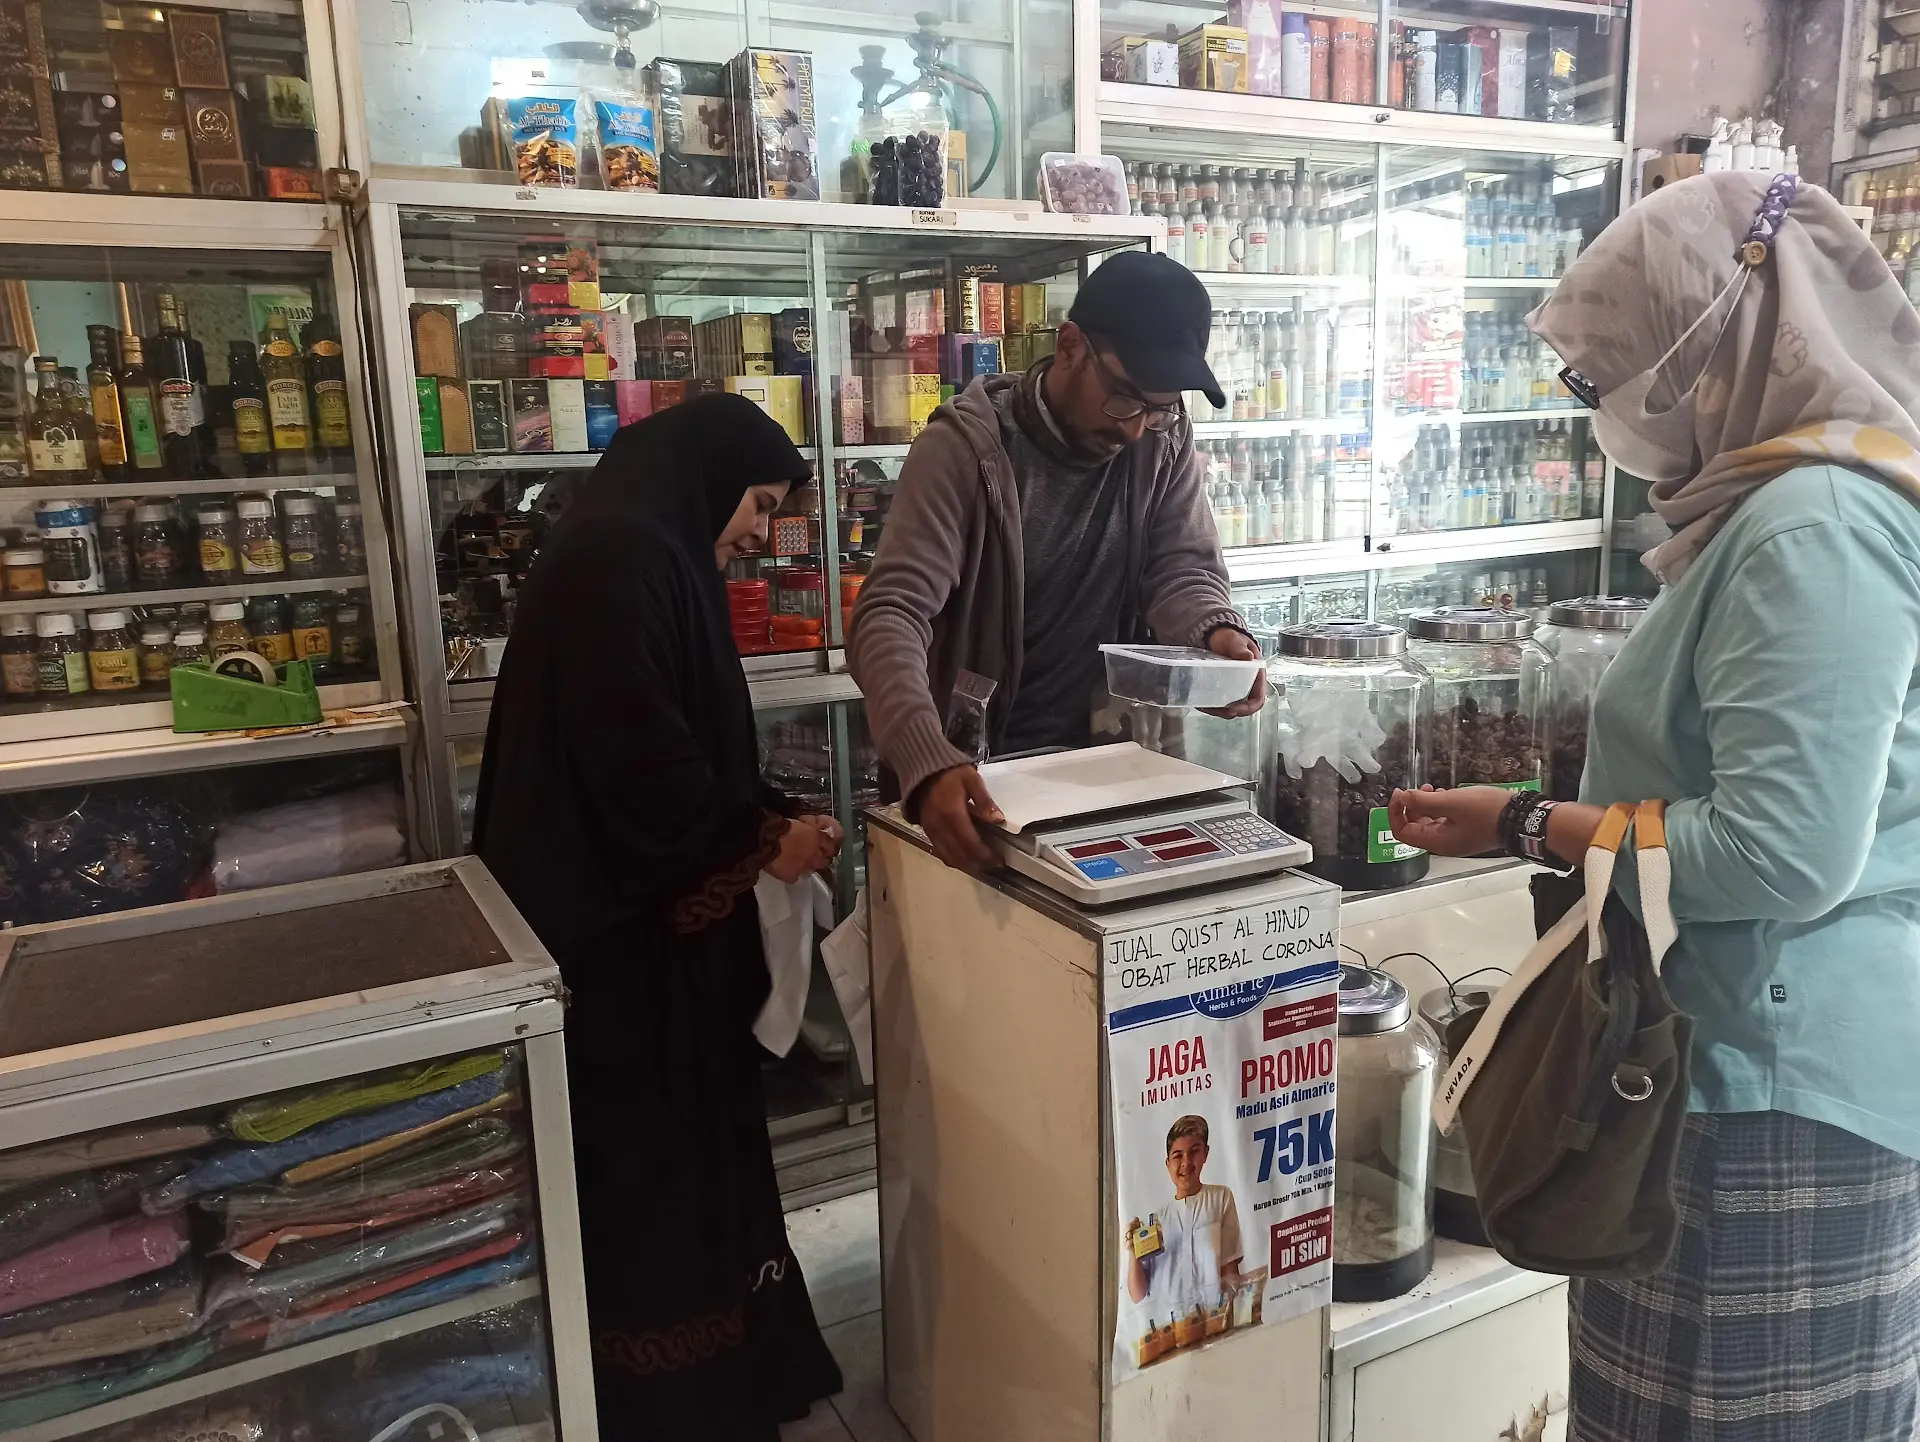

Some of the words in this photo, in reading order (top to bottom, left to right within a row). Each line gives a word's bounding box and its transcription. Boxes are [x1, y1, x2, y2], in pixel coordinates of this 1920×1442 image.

[95, 658, 127, 668] KAMIL
[1109, 934, 1162, 964] JUAL
[1172, 921, 1223, 954] QUST
[1234, 916, 1254, 939] AL
[1265, 905, 1310, 935] HIND
[1122, 961, 1176, 988] OBAT
[1187, 948, 1253, 979] HERBAL
[1262, 931, 1335, 961] CORONA
[1208, 1000, 1229, 1012] Herbs
[1230, 998, 1236, 1006] &
[1236, 994, 1257, 1005] Foods
[1145, 1035, 1207, 1085] JAGA
[1241, 1038, 1334, 1099] PROMO
[1141, 1073, 1213, 1107] IMUNITAS
[1445, 1056, 1474, 1105] NEVADA
[1236, 1102, 1267, 1119] Madu
[1270, 1092, 1289, 1110] Asli
[1291, 1081, 1336, 1104] Almari'e
[1253, 1108, 1335, 1184] 75K
[1294, 1172, 1312, 1186] /Cup
[1313, 1165, 1334, 1180] 500G
[1253, 1200, 1271, 1212] Harga
[1272, 1194, 1290, 1207] Grosir
[1317, 1180, 1333, 1190] Karto
[1277, 1221, 1307, 1238] Dapatkan
[1307, 1214, 1331, 1228] Produk
[1281, 1245, 1296, 1269] DI
[1298, 1235, 1327, 1263] SINI
